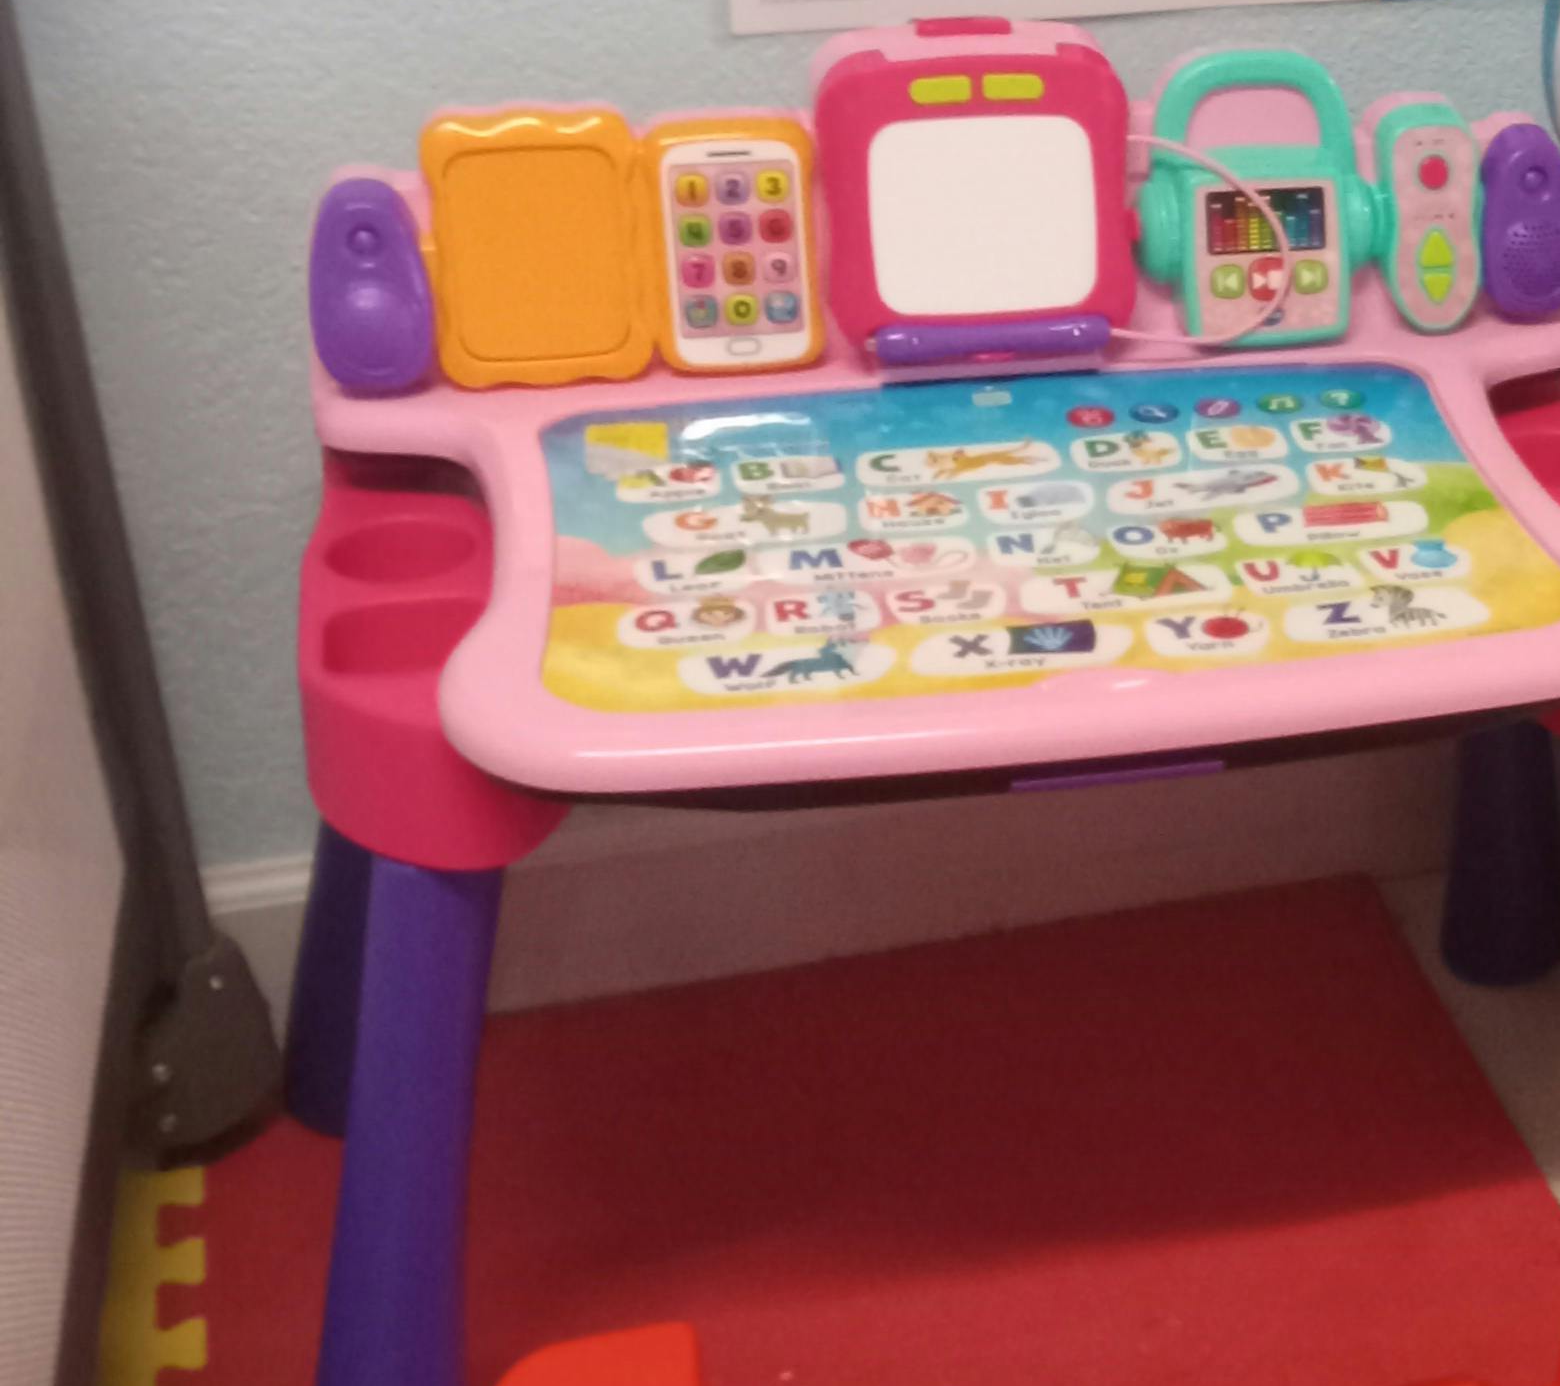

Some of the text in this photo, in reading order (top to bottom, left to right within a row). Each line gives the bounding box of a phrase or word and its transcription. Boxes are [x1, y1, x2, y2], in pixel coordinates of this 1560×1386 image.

[1196, 430, 1226, 448] E
[1299, 422, 1323, 440] F
[1084, 439, 1119, 458] D
[739, 461, 773, 480] B
[869, 454, 902, 472] C
[1313, 464, 1349, 482] K
[988, 490, 1009, 510] I
[1124, 480, 1153, 500] J
[674, 511, 718, 531] G
[1257, 513, 1293, 533] P
[996, 533, 1035, 554] N
[1113, 526, 1154, 545] O
[789, 548, 843, 570] M
[1369, 548, 1399, 569] V
[651, 560, 684, 581] L
[1243, 560, 1281, 582] U
[1053, 577, 1087, 599] T
[774, 600, 809, 622] R
[895, 590, 936, 612] S
[635, 610, 679, 632] Q
[1316, 601, 1363, 625] Z
[1156, 616, 1197, 640] Y
[949, 634, 993, 658] X
[706, 654, 762, 679] W
